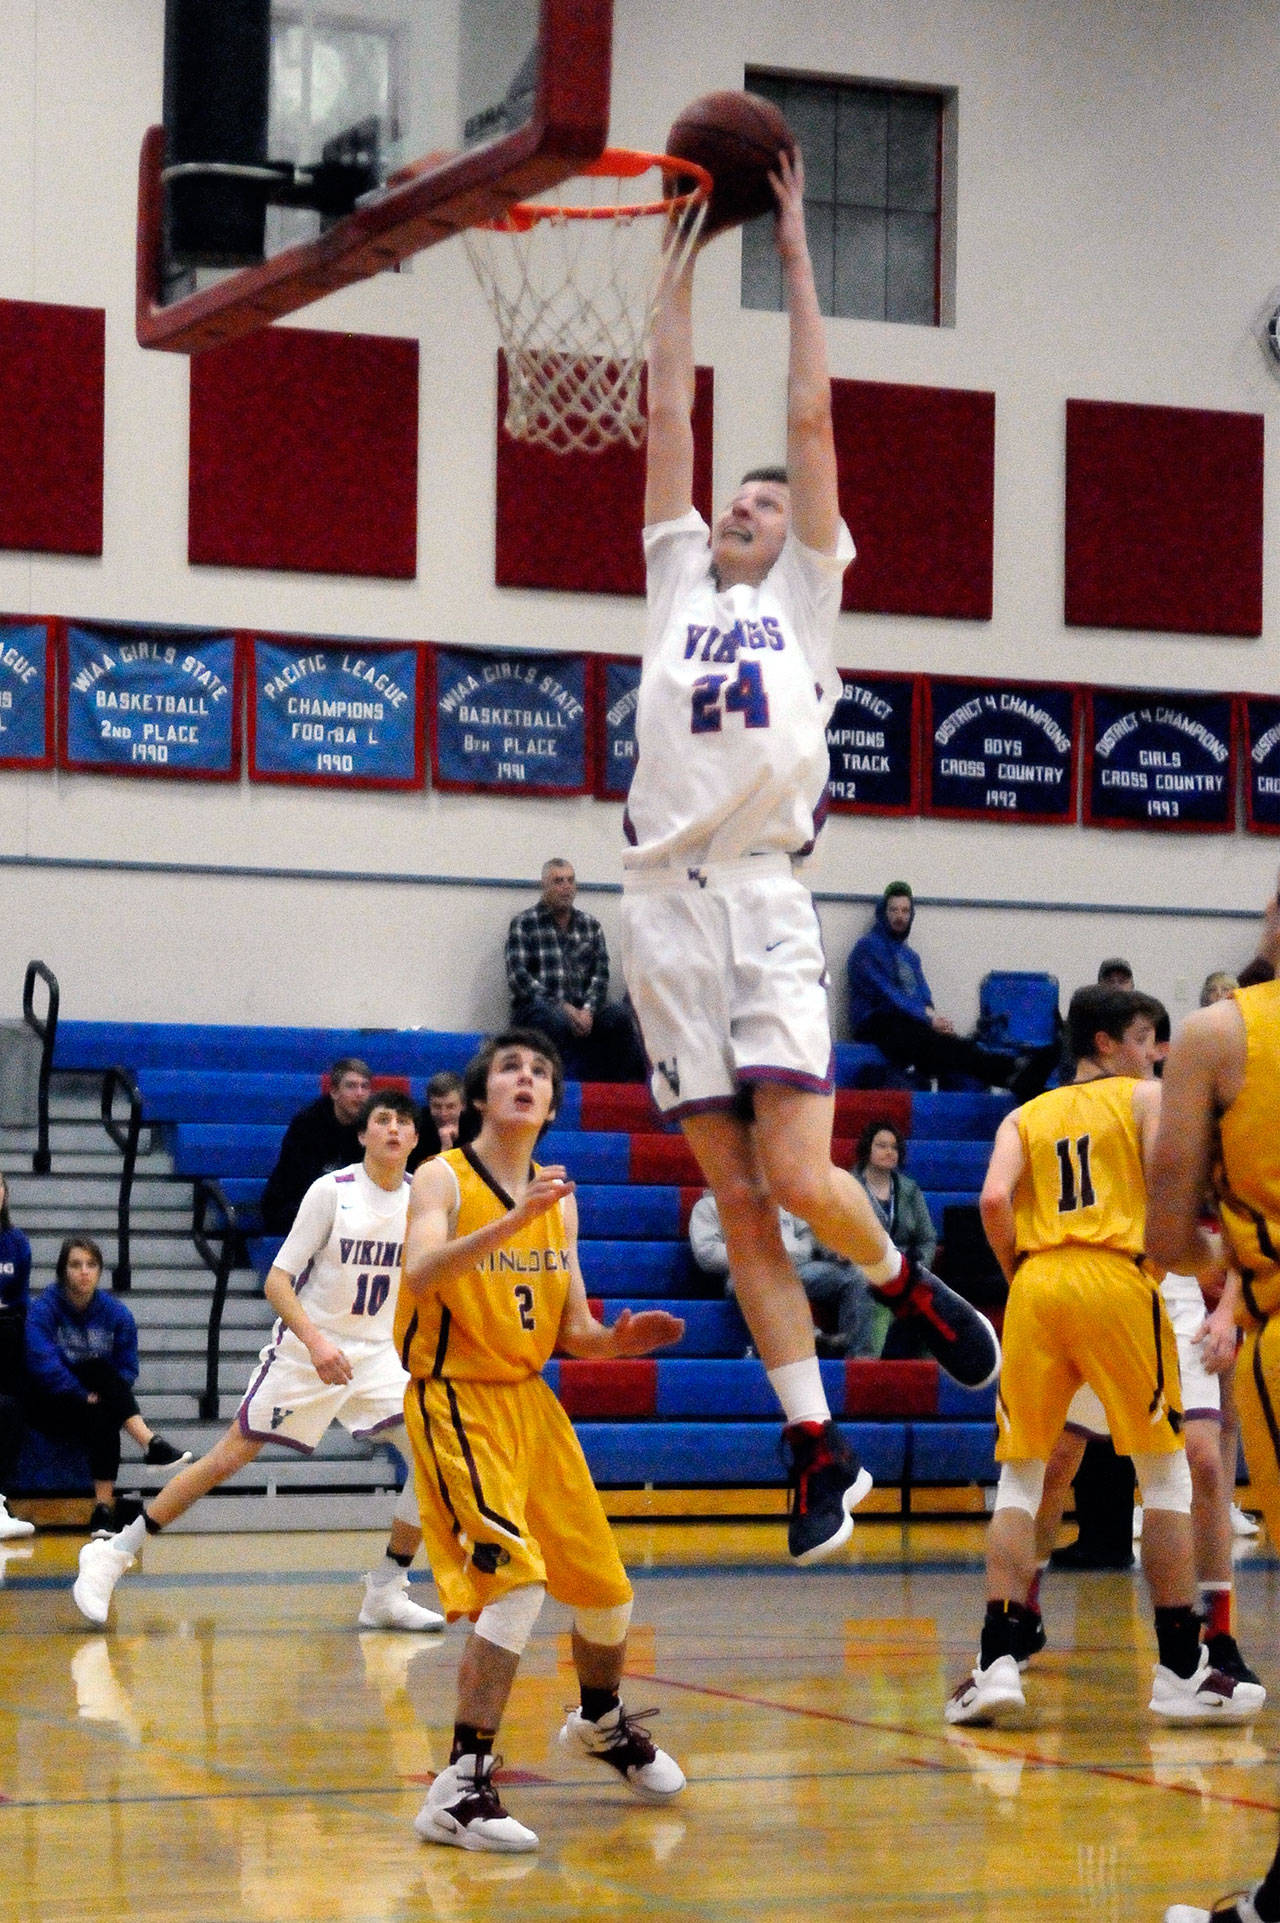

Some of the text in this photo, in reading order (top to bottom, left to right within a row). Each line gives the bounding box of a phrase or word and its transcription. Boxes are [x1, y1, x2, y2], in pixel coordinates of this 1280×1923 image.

[72, 642, 228, 701] WIAA GIRLS STATE
[264, 654, 408, 708] PACIFIC LEAGUE
[483, 662, 537, 684] GIRLS
[539, 675, 584, 720] STATE
[691, 659, 770, 733] 24
[843, 684, 893, 719] STRICT
[96, 690, 209, 716] BASKETBALL
[287, 697, 384, 720] CHAMPIONS
[458, 705, 567, 728] BASKETBALL
[935, 694, 1071, 753] DISTRICT 4 CHAMPIONS
[100, 719, 199, 744] 2ND PLACE
[827, 729, 886, 749] MPIONS
[1095, 706, 1229, 762] DISTRICT 4 CHAMPIONS
[132, 743, 169, 763] 1990
[463, 734, 557, 757] 8TH PLACE
[984, 738, 1023, 756] BOYS
[317, 753, 353, 772] 1990
[842, 753, 891, 772] TRACK
[1139, 750, 1181, 767] GIRLS
[497, 763, 526, 780] 1991
[941, 758, 1064, 784] CROSS COUNTRY
[1101, 769, 1224, 792] CROSS COUNTRY
[828, 781, 857, 799] 992
[986, 789, 1018, 808] 1992
[1147, 800, 1180, 816] 1993
[1055, 1135, 1096, 1213] 11
[350, 1273, 391, 1317] 10
[514, 1285, 536, 1331] 2
